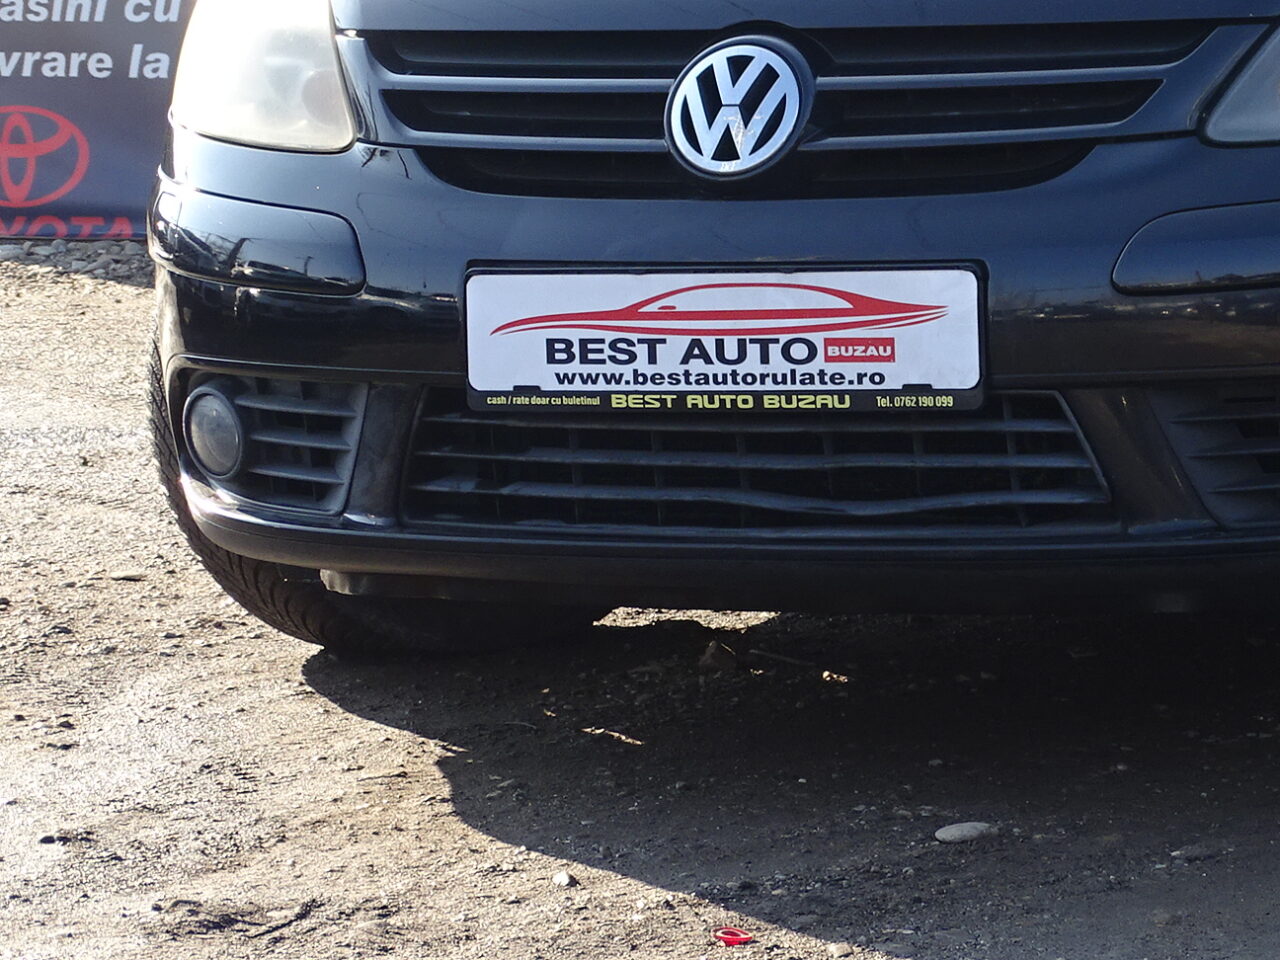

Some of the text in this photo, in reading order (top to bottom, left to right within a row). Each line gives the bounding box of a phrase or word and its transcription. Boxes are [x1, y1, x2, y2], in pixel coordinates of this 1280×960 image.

[128, 43, 170, 78] la
[545, 337, 893, 366] BEST AUTO BUZAU
[554, 368, 886, 387] www.bestautorulate.ro
[486, 395, 506, 405] cash
[512, 395, 530, 406] rate
[530, 395, 550, 405] doar
[551, 397, 562, 405] cu
[562, 395, 601, 406] buletinul
[611, 394, 677, 409] BEST
[686, 394, 754, 409] AUTO
[763, 394, 851, 409] BUZAU
[876, 396, 893, 408] Tel.
[894, 396, 916, 407] 0762
[918, 396, 934, 407] 190
[935, 396, 954, 407] 099
